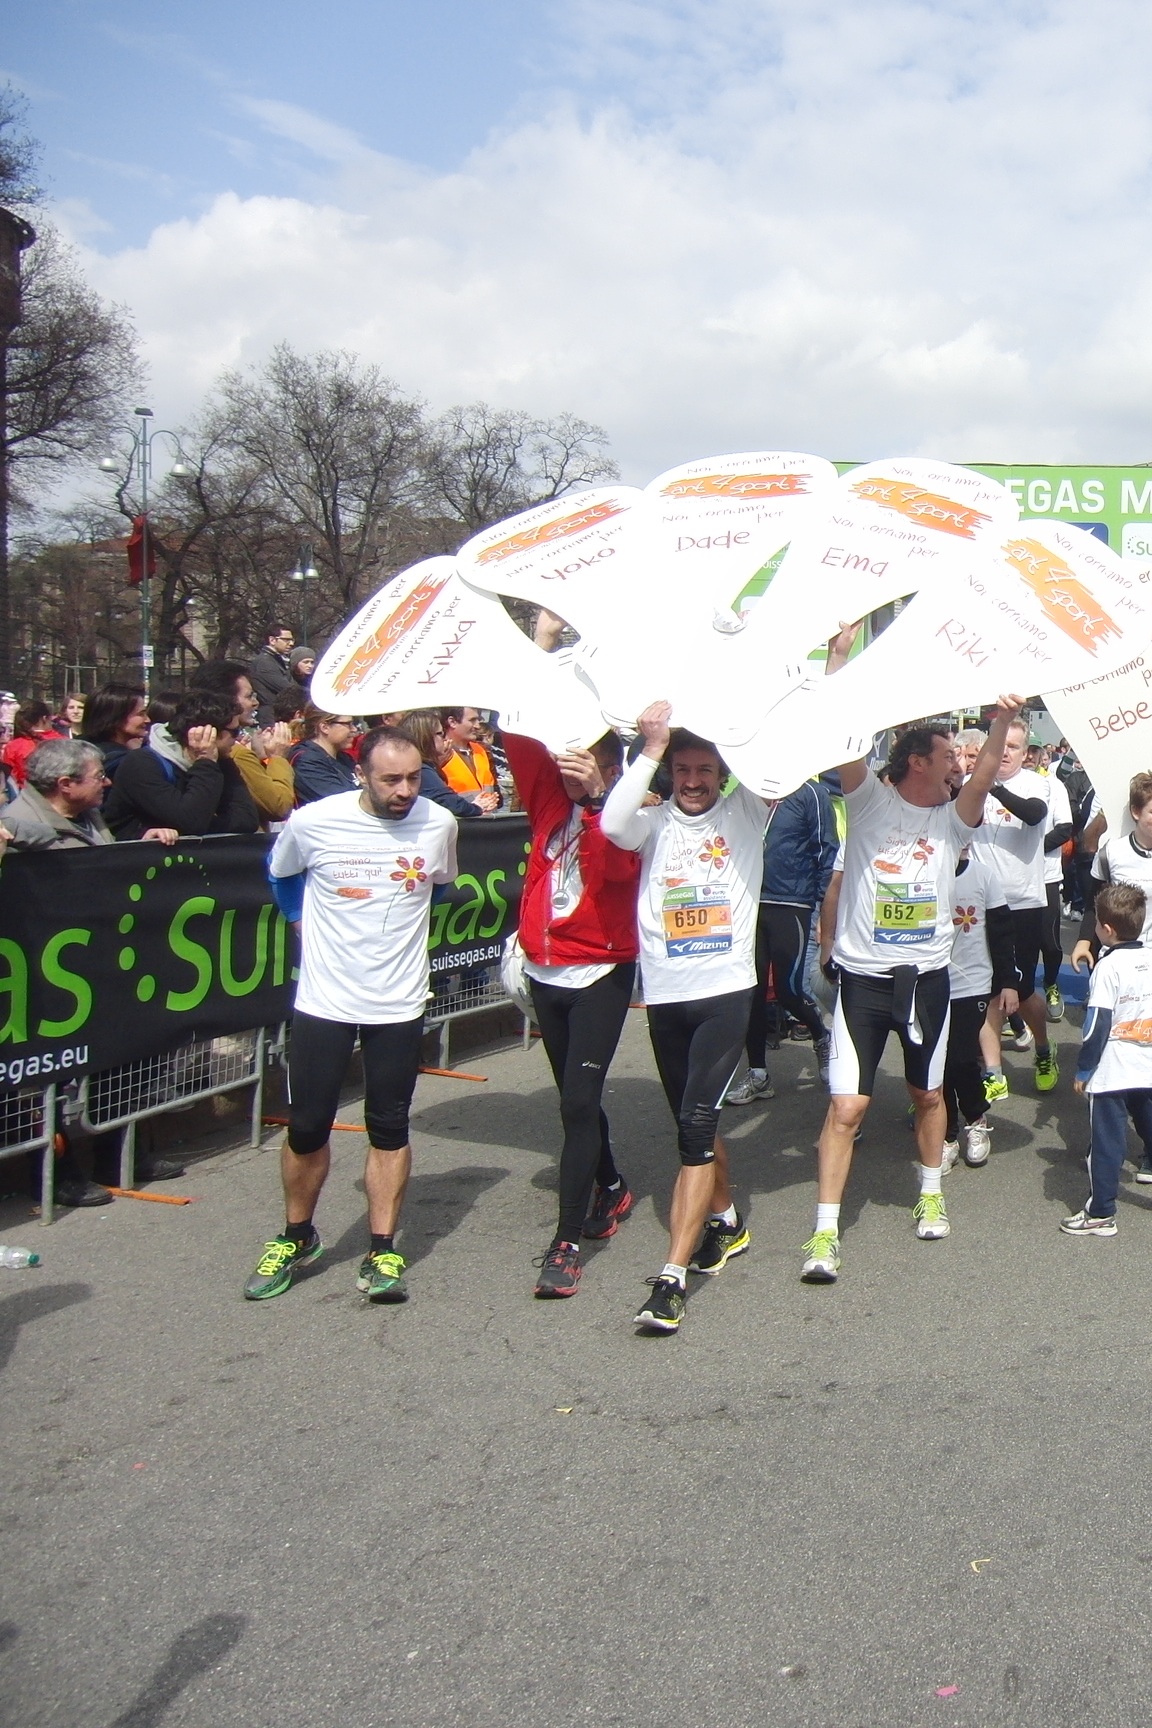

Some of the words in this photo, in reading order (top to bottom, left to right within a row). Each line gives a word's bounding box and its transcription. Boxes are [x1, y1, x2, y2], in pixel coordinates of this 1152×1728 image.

[671, 480, 706, 495] art
[712, 475, 738, 490] 4
[730, 476, 792, 495] sport
[860, 484, 896, 502] art
[900, 489, 927, 503] 4
[907, 502, 968, 528] sport
[487, 541, 523, 561] art
[522, 527, 542, 541] 4
[546, 508, 606, 538] sport
[674, 530, 750, 553] Dade
[820, 547, 890, 578] Ema
[1010, 546, 1048, 575] art
[1044, 567, 1077, 584] 4
[325, 654, 346, 675] Noi
[346, 600, 381, 648] corriamo
[388, 578, 407, 599] per
[1044, 588, 1104, 636] sport
[343, 658, 374, 688] art
[365, 634, 380, 654] 4
[386, 592, 432, 640] sport
[378, 672, 400, 694] Noi
[402, 610, 441, 664] corriamo
[442, 596, 461, 618] per
[417, 620, 476, 684] Kikka
[934, 618, 998, 668] Riki
[1088, 701, 1152, 741] Bebe
[674, 908, 708, 928] 650
[720, 910, 728, 922] 3
[884, 904, 915, 920] 652
[924, 906, 932, 917] 2
